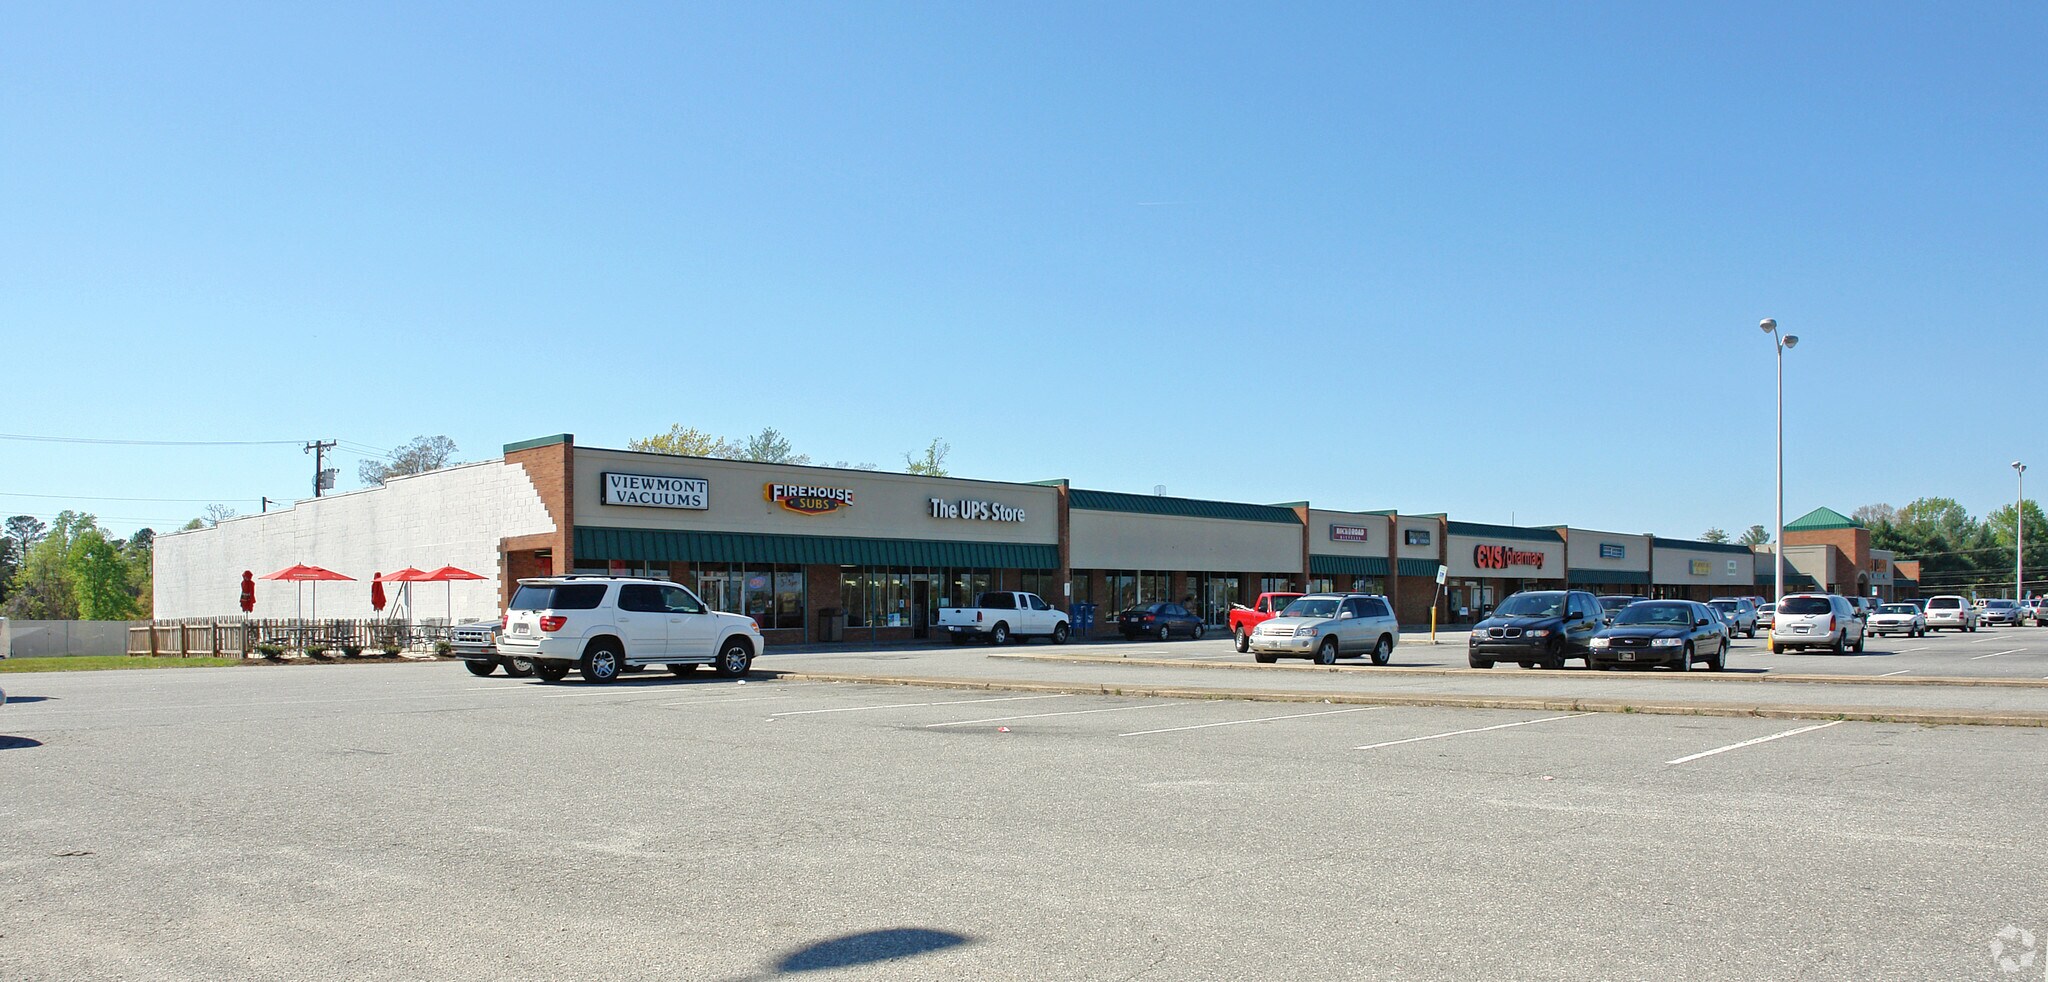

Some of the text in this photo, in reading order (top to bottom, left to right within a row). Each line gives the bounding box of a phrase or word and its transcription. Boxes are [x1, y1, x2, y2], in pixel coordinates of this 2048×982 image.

[611, 476, 706, 493] VIEWMONT
[616, 491, 701, 507] VACUUMS
[773, 484, 854, 506] FIREHOUSE
[799, 498, 829, 510] SUBS
[931, 498, 1026, 522] The UPS Store
